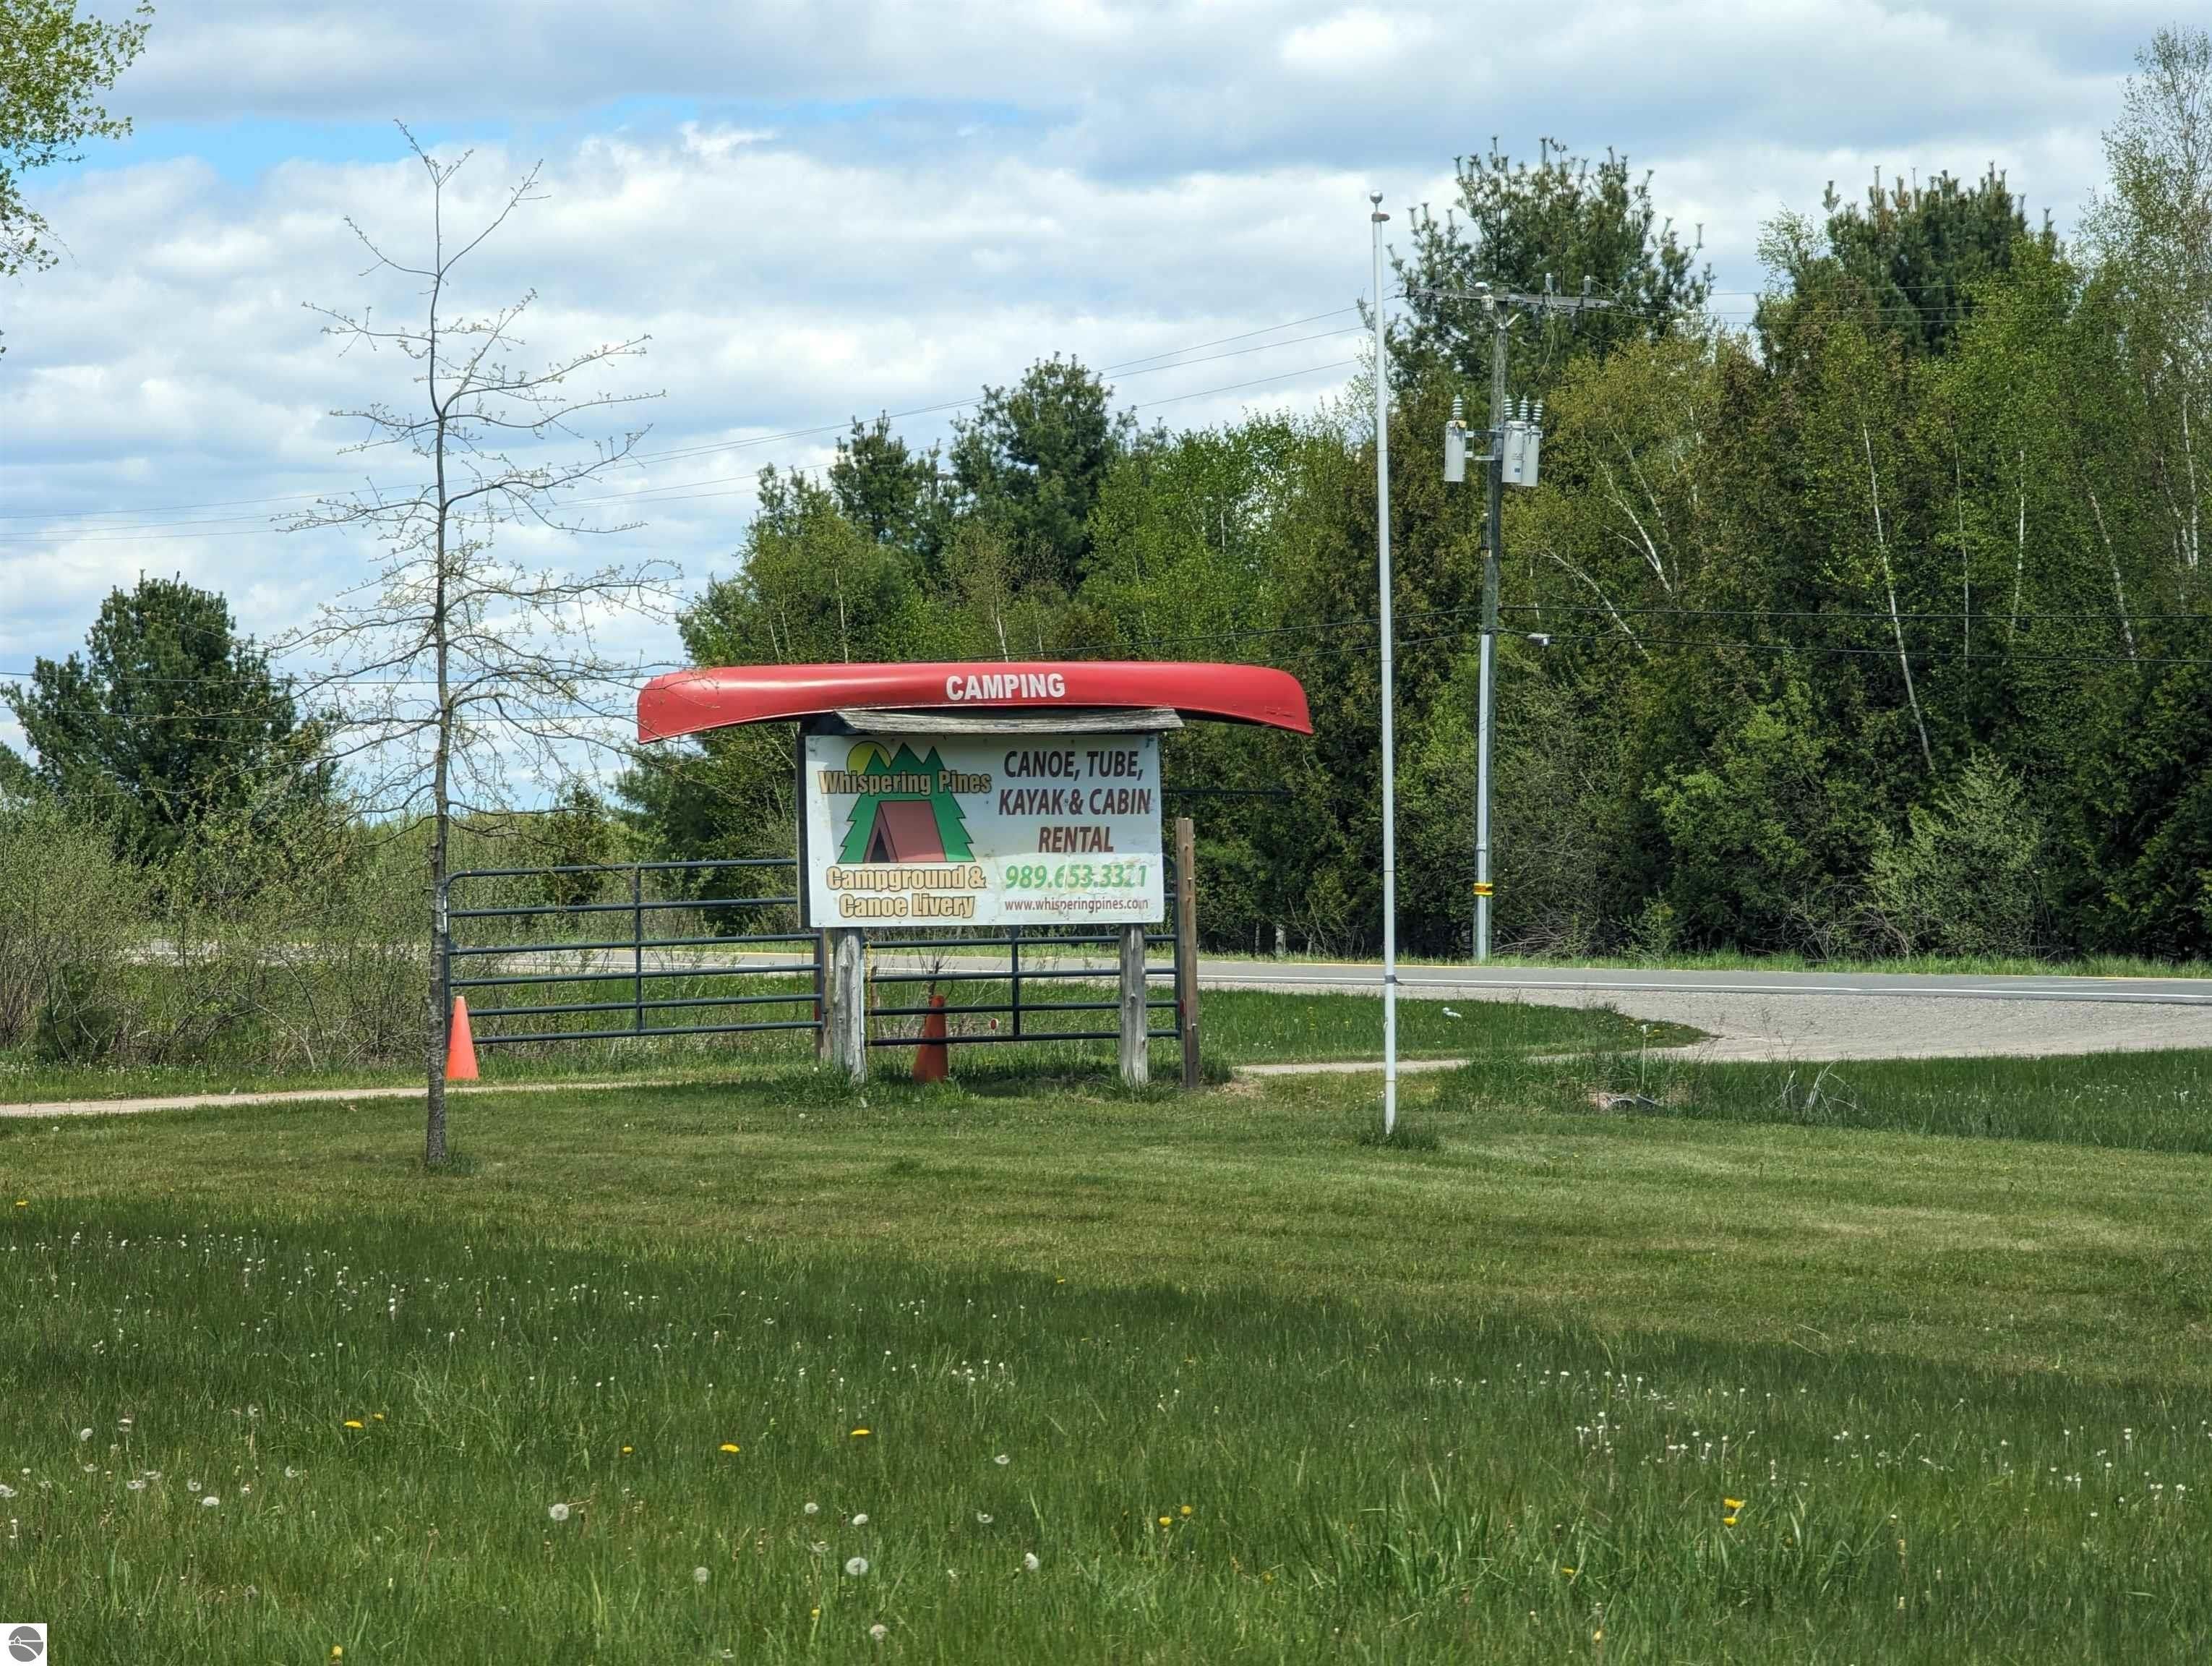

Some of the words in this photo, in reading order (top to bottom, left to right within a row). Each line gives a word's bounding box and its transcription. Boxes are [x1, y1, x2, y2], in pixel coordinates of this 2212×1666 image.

[946, 673, 1066, 701] CAMPING
[1004, 751, 1080, 781] CANOE,
[1086, 751, 1144, 781] TUBE,
[818, 770, 932, 795] Whispering
[938, 770, 992, 793] Pines
[999, 789, 1064, 816] KAYAK
[1068, 789, 1084, 815] &
[1089, 789, 1152, 815] CABIN
[1038, 826, 1114, 853] RENTAL
[826, 865, 965, 892] Campground
[968, 866, 987, 889] &
[839, 893, 908, 918] Canoe
[912, 892, 975, 918] Livery
[1005, 897, 1149, 913] www.whisperingpines.com
